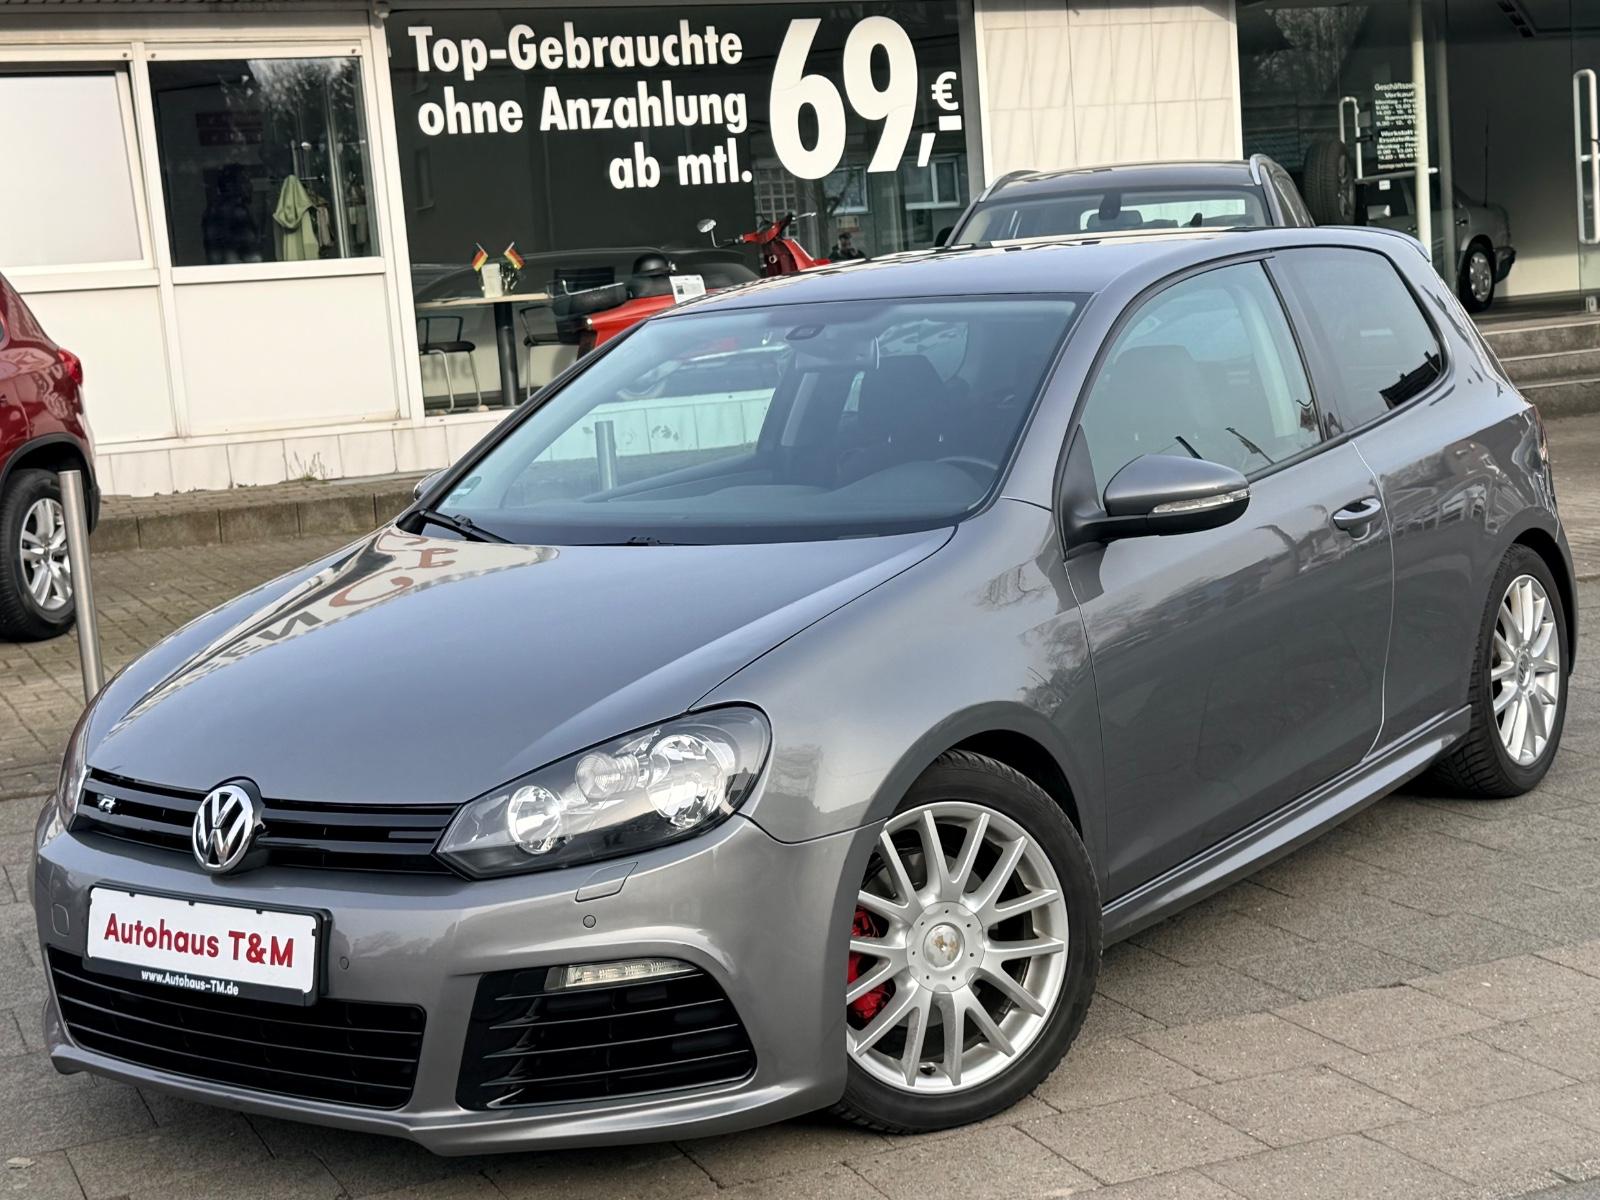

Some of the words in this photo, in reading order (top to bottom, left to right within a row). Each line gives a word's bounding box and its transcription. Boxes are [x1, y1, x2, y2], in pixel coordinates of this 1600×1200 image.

[408, 20, 743, 81] Top-Gebrauchte
[417, 86, 524, 135] ohne
[539, 81, 748, 134] Anzahlung
[609, 141, 661, 189] ab
[678, 138, 753, 186] mtl.
[104, 913, 219, 958] Autohaus
[228, 930, 295, 968] T&M
[141, 969, 240, 996] www.Autohaus-TM.de
